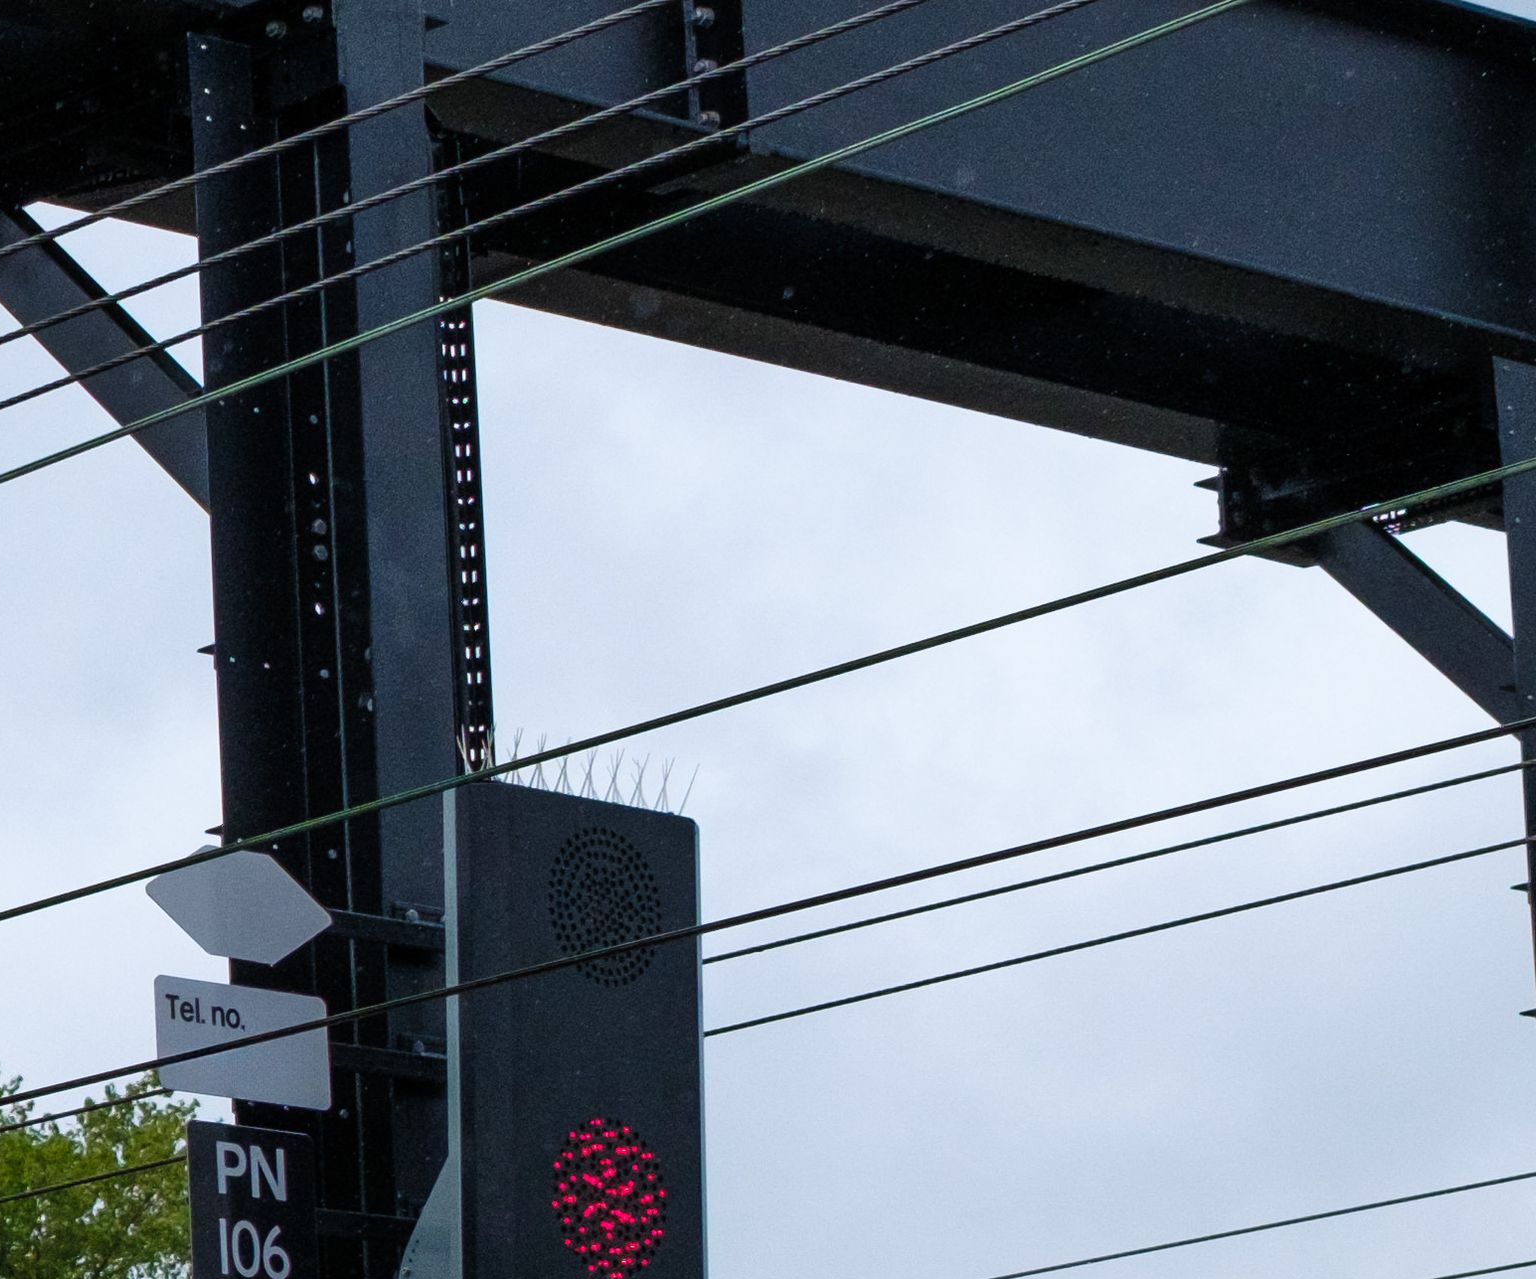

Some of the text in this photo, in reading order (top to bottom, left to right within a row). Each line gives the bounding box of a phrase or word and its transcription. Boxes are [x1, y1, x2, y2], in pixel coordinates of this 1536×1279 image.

[165, 993, 245, 1031] Tel. no.
[216, 1140, 287, 1202] PN
